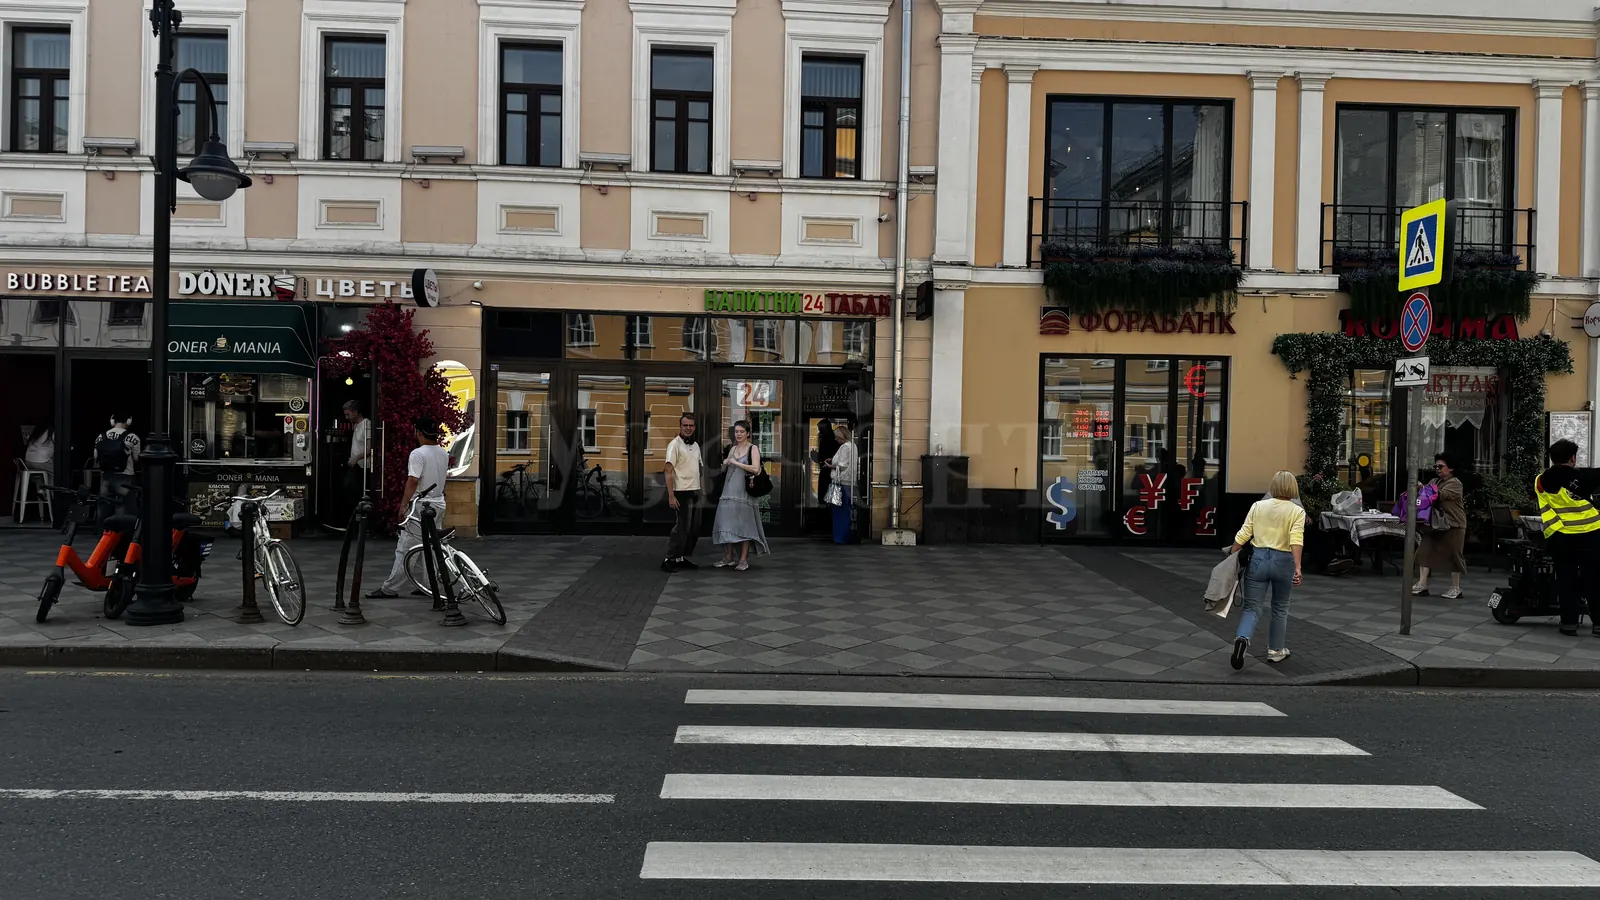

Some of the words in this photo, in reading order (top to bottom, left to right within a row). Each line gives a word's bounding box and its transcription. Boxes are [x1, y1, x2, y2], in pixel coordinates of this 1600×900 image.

[7, 272, 98, 292] BUBBLE
[107, 275, 151, 293] TEA
[704, 289, 800, 313] НАПИТКИ
[803, 294, 824, 311] 24
[827, 293, 892, 316] ТАБАК
[1079, 309, 1236, 334] ФОРАБАНК
[167, 340, 208, 354] ONER
[233, 341, 282, 354] MANIA
[739, 383, 766, 406] 24
[216, 474, 243, 482] DONER
[1078, 470, 1109, 478] ДОЛЛАРЫ
[1078, 477, 1104, 485] НОВОГО
[1077, 484, 1107, 492] ОБРАЗЦА
